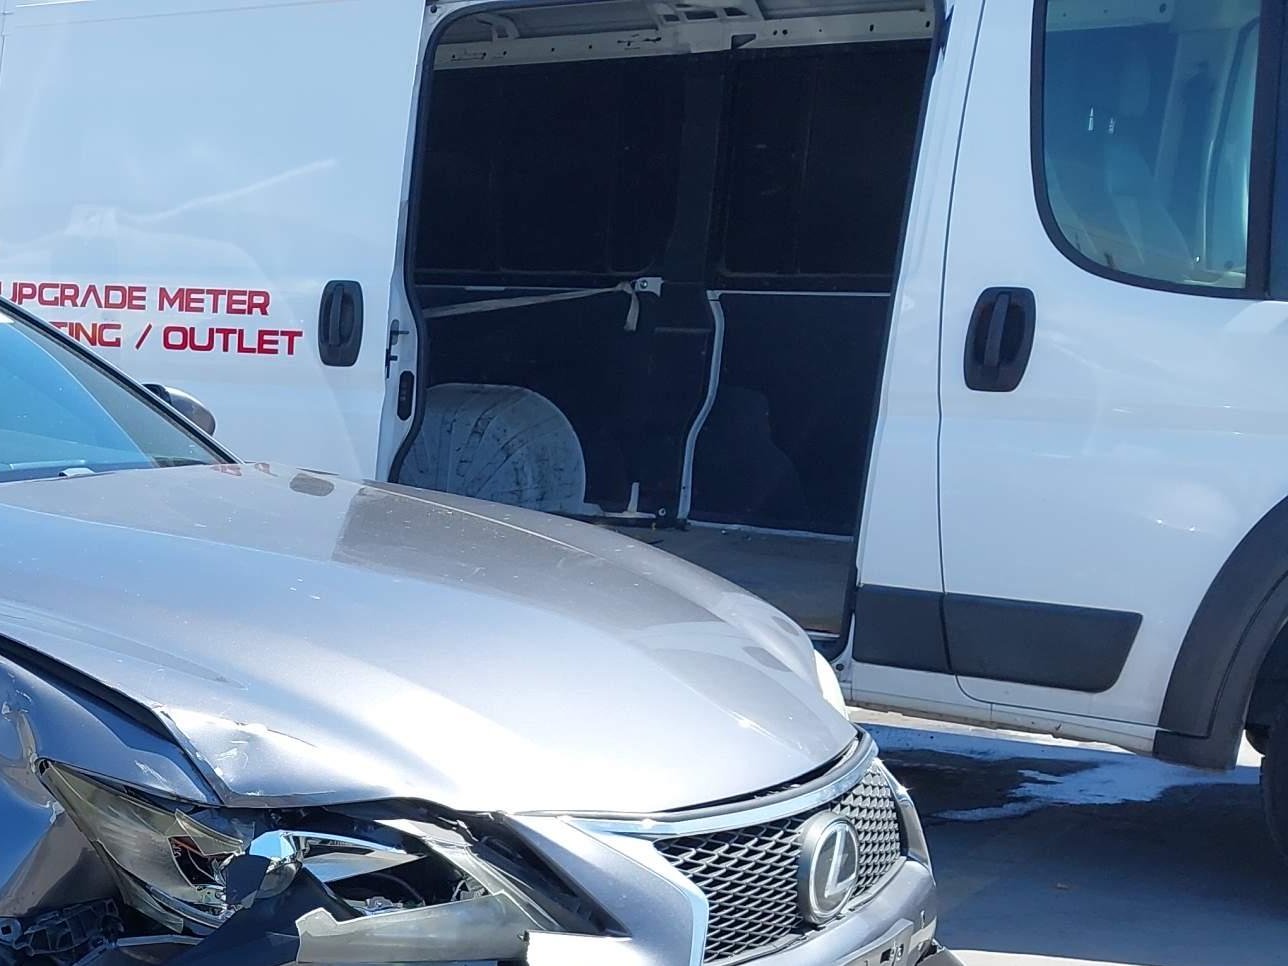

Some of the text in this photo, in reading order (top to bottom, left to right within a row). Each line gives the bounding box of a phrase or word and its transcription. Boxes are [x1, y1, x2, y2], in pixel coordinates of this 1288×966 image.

[158, 286, 270, 316] METER
[135, 323, 152, 350] /
[163, 326, 303, 355] OUTLET
